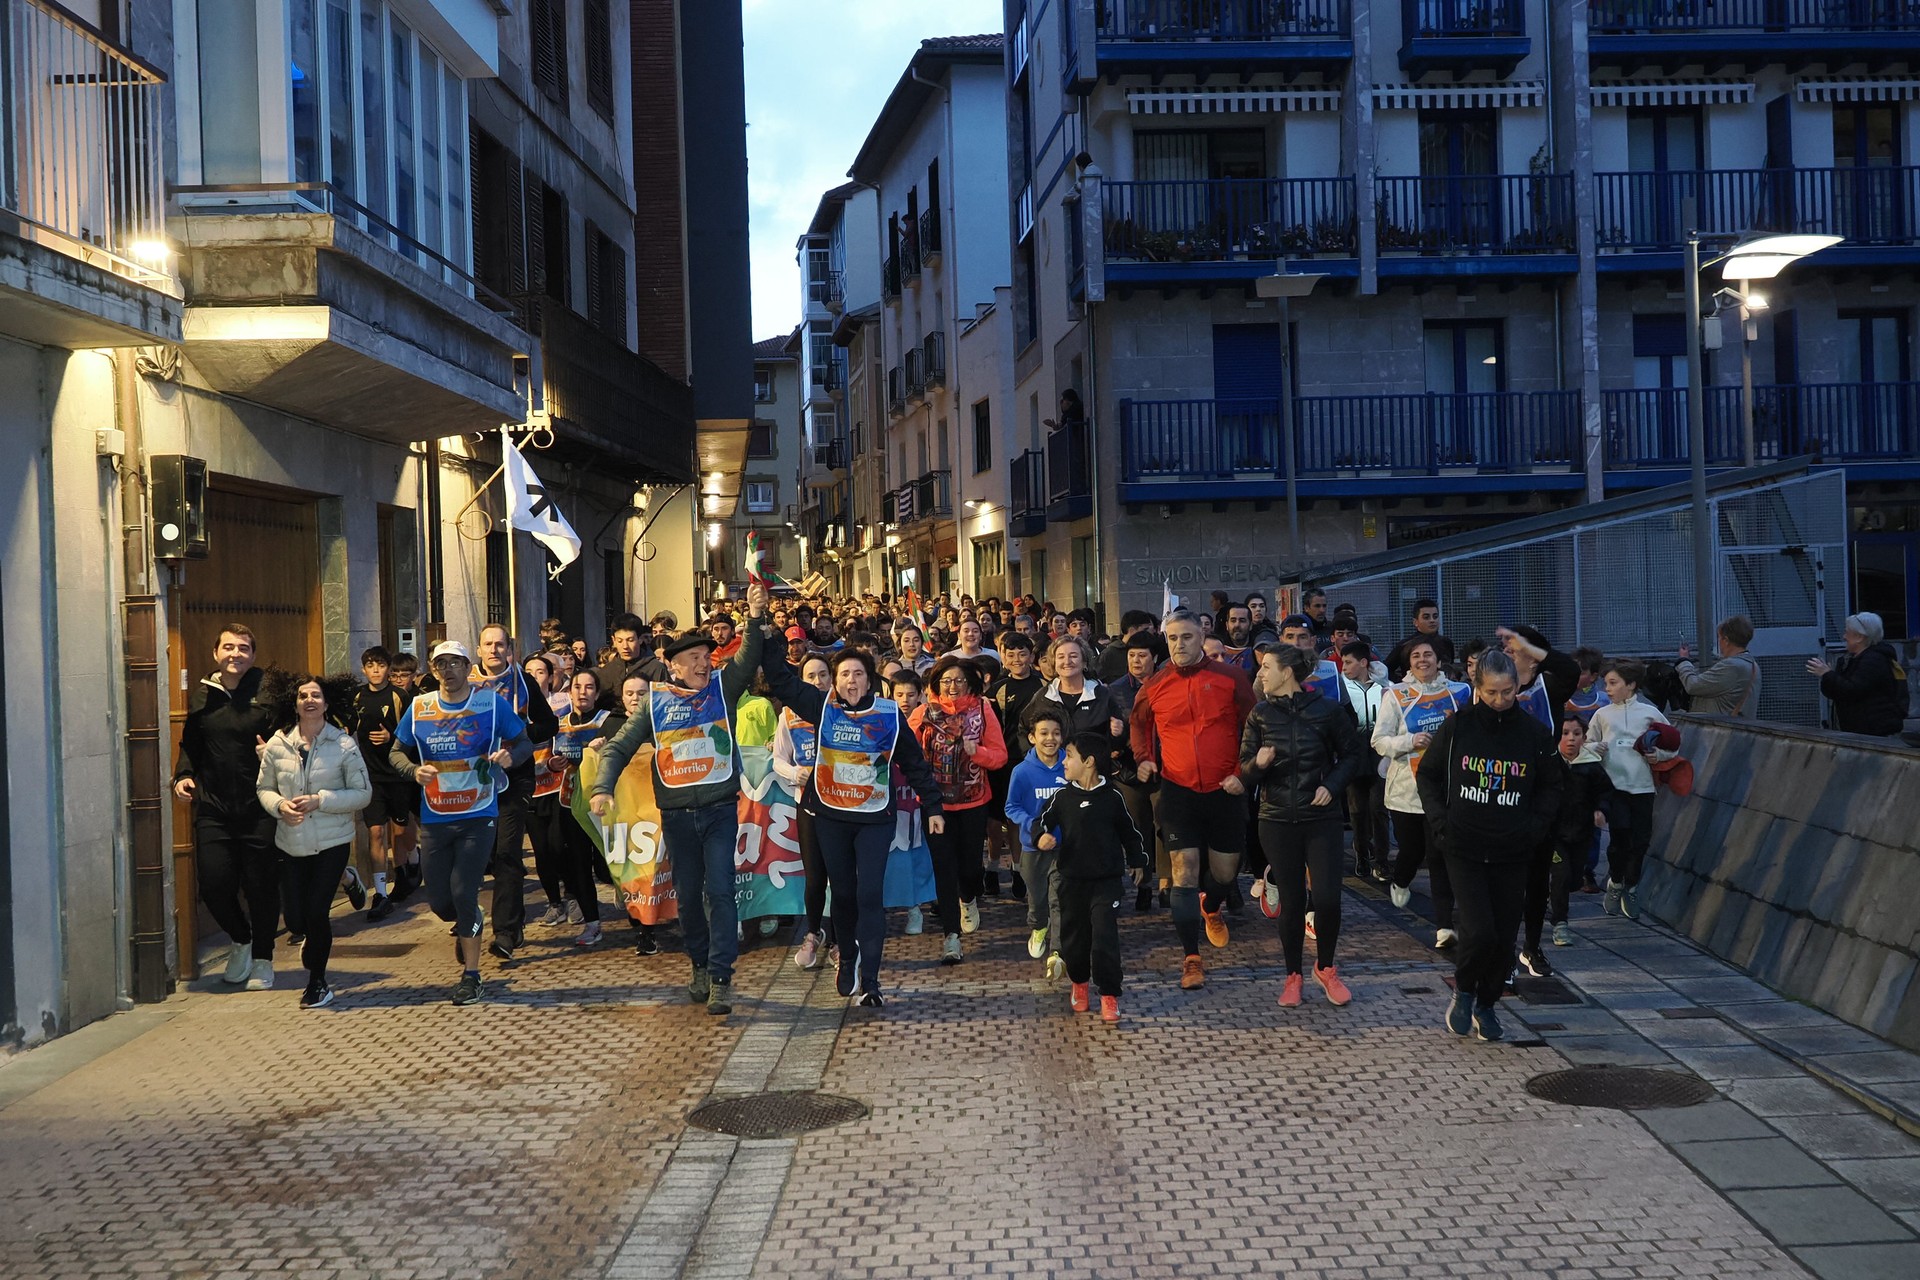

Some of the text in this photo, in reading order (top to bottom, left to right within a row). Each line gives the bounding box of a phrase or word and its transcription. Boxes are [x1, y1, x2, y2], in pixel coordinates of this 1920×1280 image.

[1135, 564, 1210, 585] SIMON
[832, 723, 861, 733] Euskara
[833, 730, 861, 742] gara
[430, 742, 457, 754] gara
[1461, 755, 1527, 777] euskaraz
[1479, 772, 1506, 791] bizi
[821, 785, 865, 799] 24.korrika
[1460, 784, 1522, 806] nahi dut
